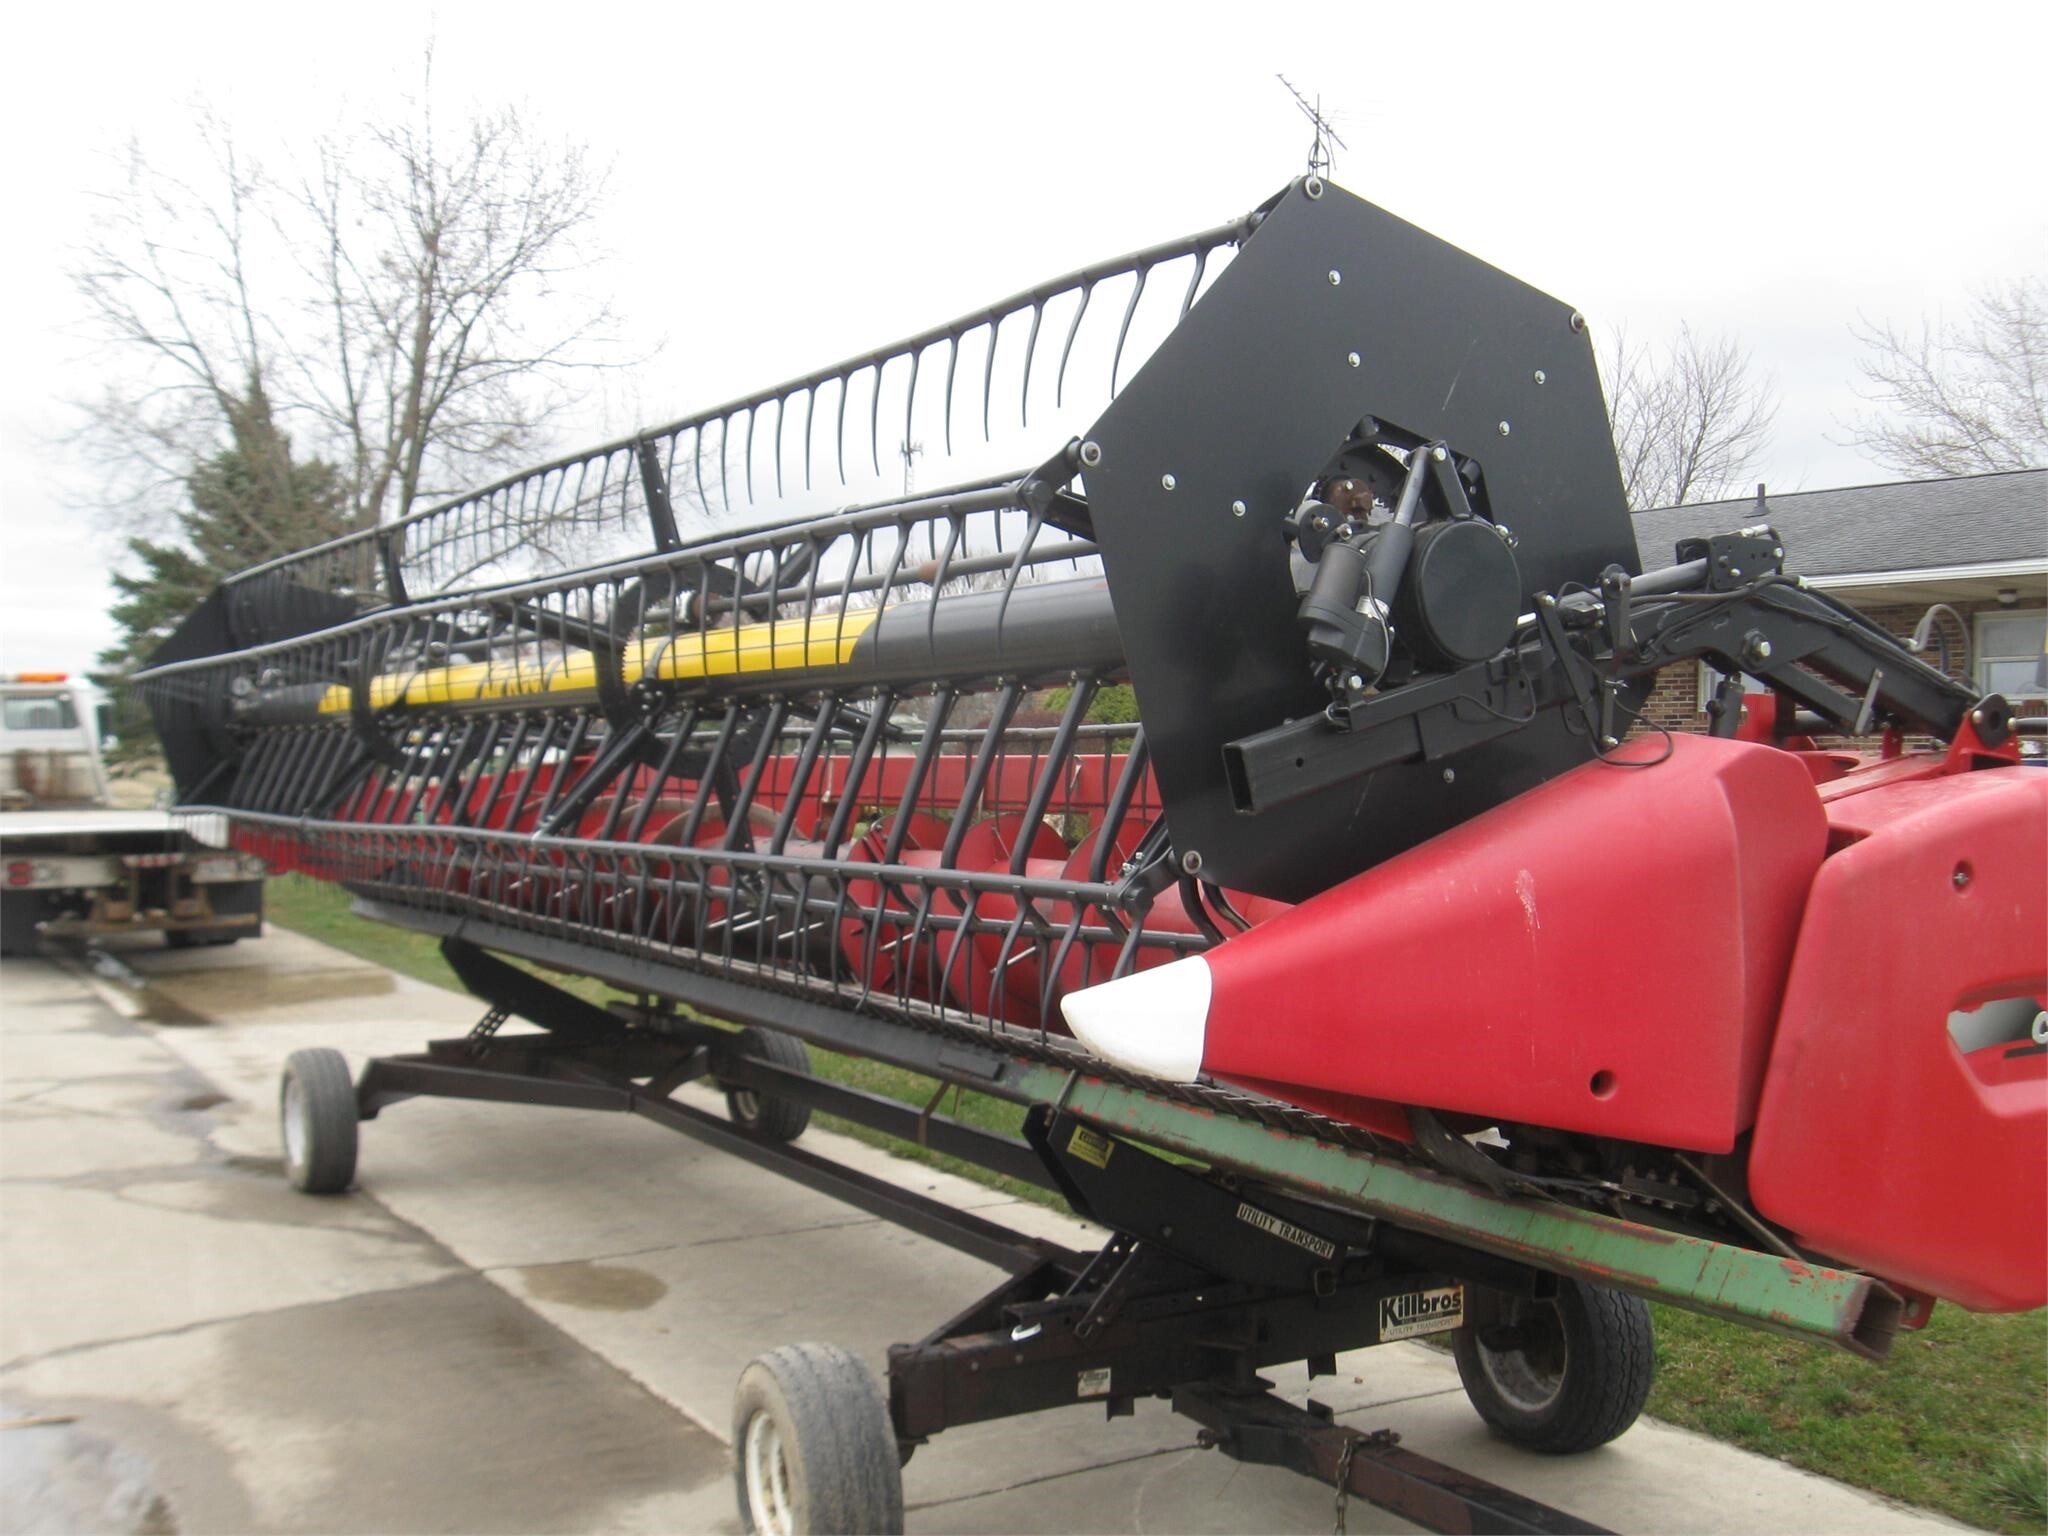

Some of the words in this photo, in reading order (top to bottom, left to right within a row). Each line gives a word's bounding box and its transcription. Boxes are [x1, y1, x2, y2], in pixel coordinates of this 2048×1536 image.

[1239, 1205, 1275, 1230] UTILITY
[1279, 1223, 1333, 1257] TRANSPORT
[1381, 1292, 1462, 1329] Killbros
